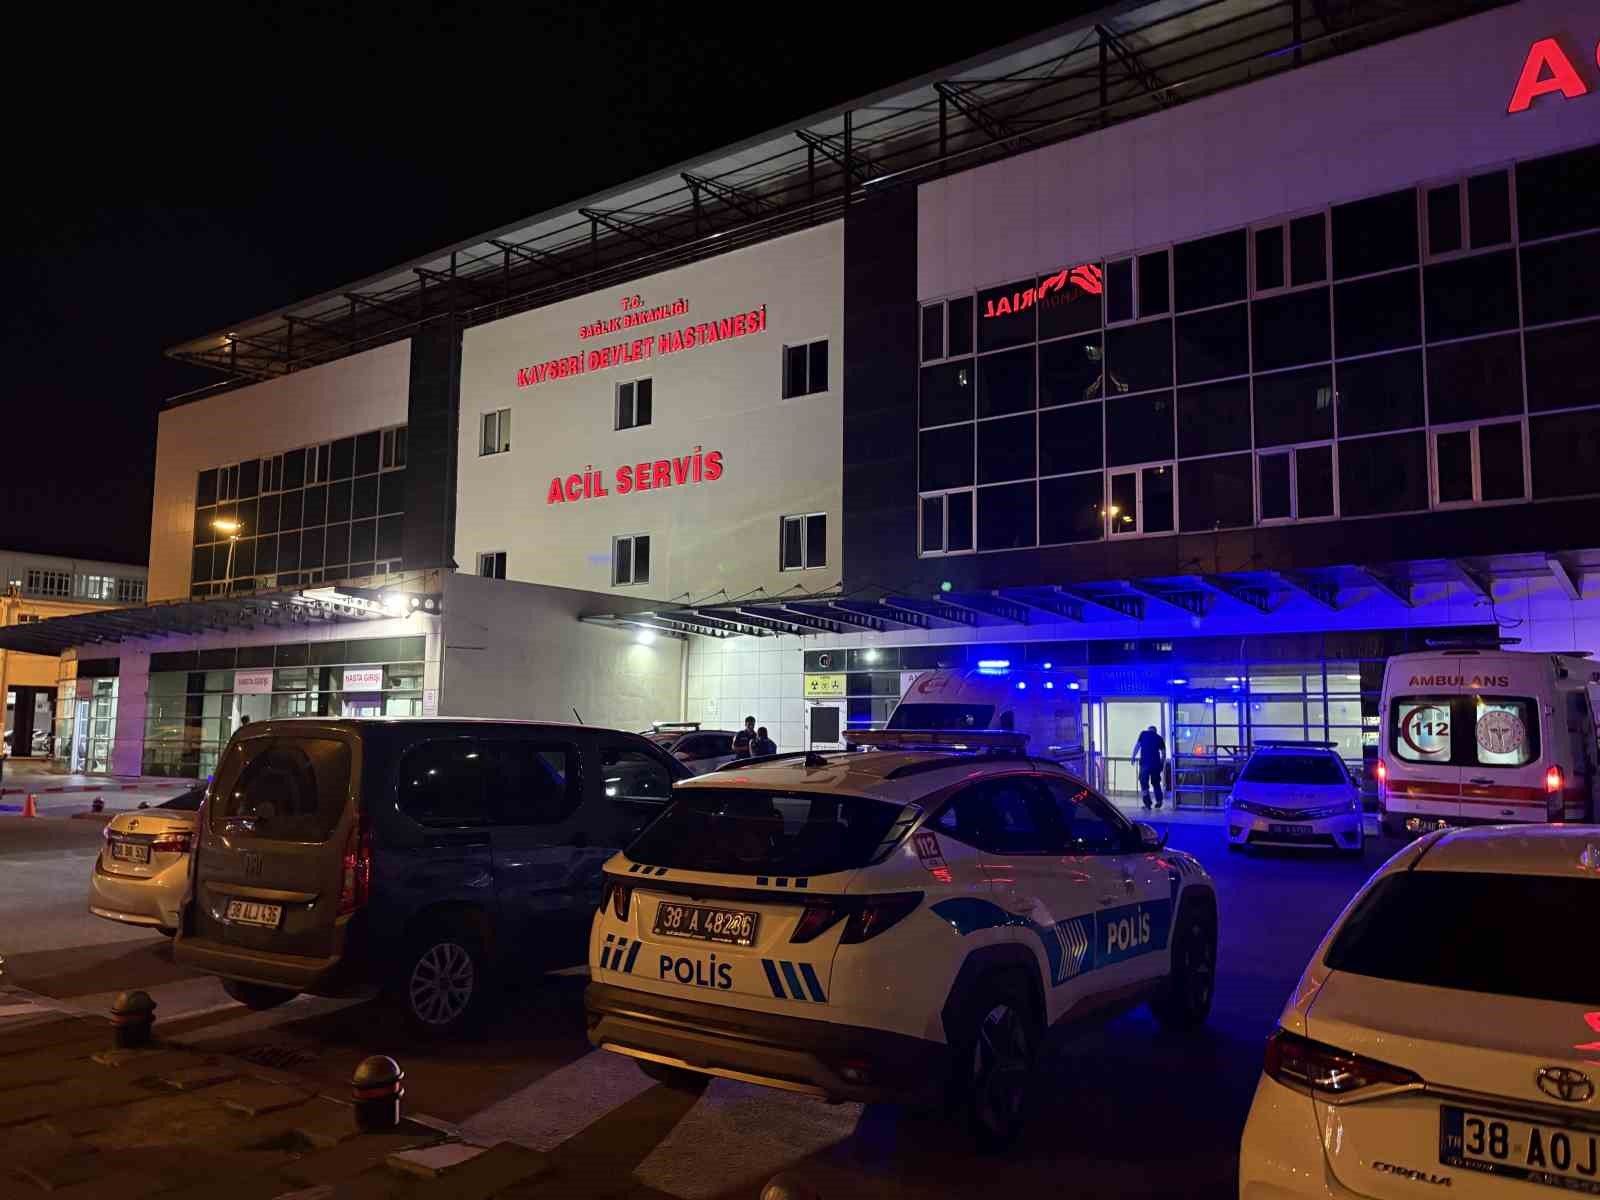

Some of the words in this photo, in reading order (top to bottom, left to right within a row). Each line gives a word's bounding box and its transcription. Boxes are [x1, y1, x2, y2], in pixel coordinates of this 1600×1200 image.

[1507, 37, 1600, 113] A
[517, 350, 585, 387] KAYSERİ
[589, 336, 655, 371] DEVLET
[658, 303, 767, 355] HASTANESİ
[579, 317, 621, 339] SAĞLIK
[547, 464, 609, 504] ACİL
[616, 446, 724, 494] SERVİS
[1408, 675, 1510, 688] AMBULANS
[1411, 722, 1449, 736] 112
[916, 837, 939, 857] 112
[663, 906, 683, 928] 38
[689, 909, 699, 931] A
[1107, 903, 1151, 955] POLİS
[660, 952, 732, 990] POLİS
[1465, 1118, 1510, 1160] 38
[1526, 1127, 1597, 1177] AOJ
